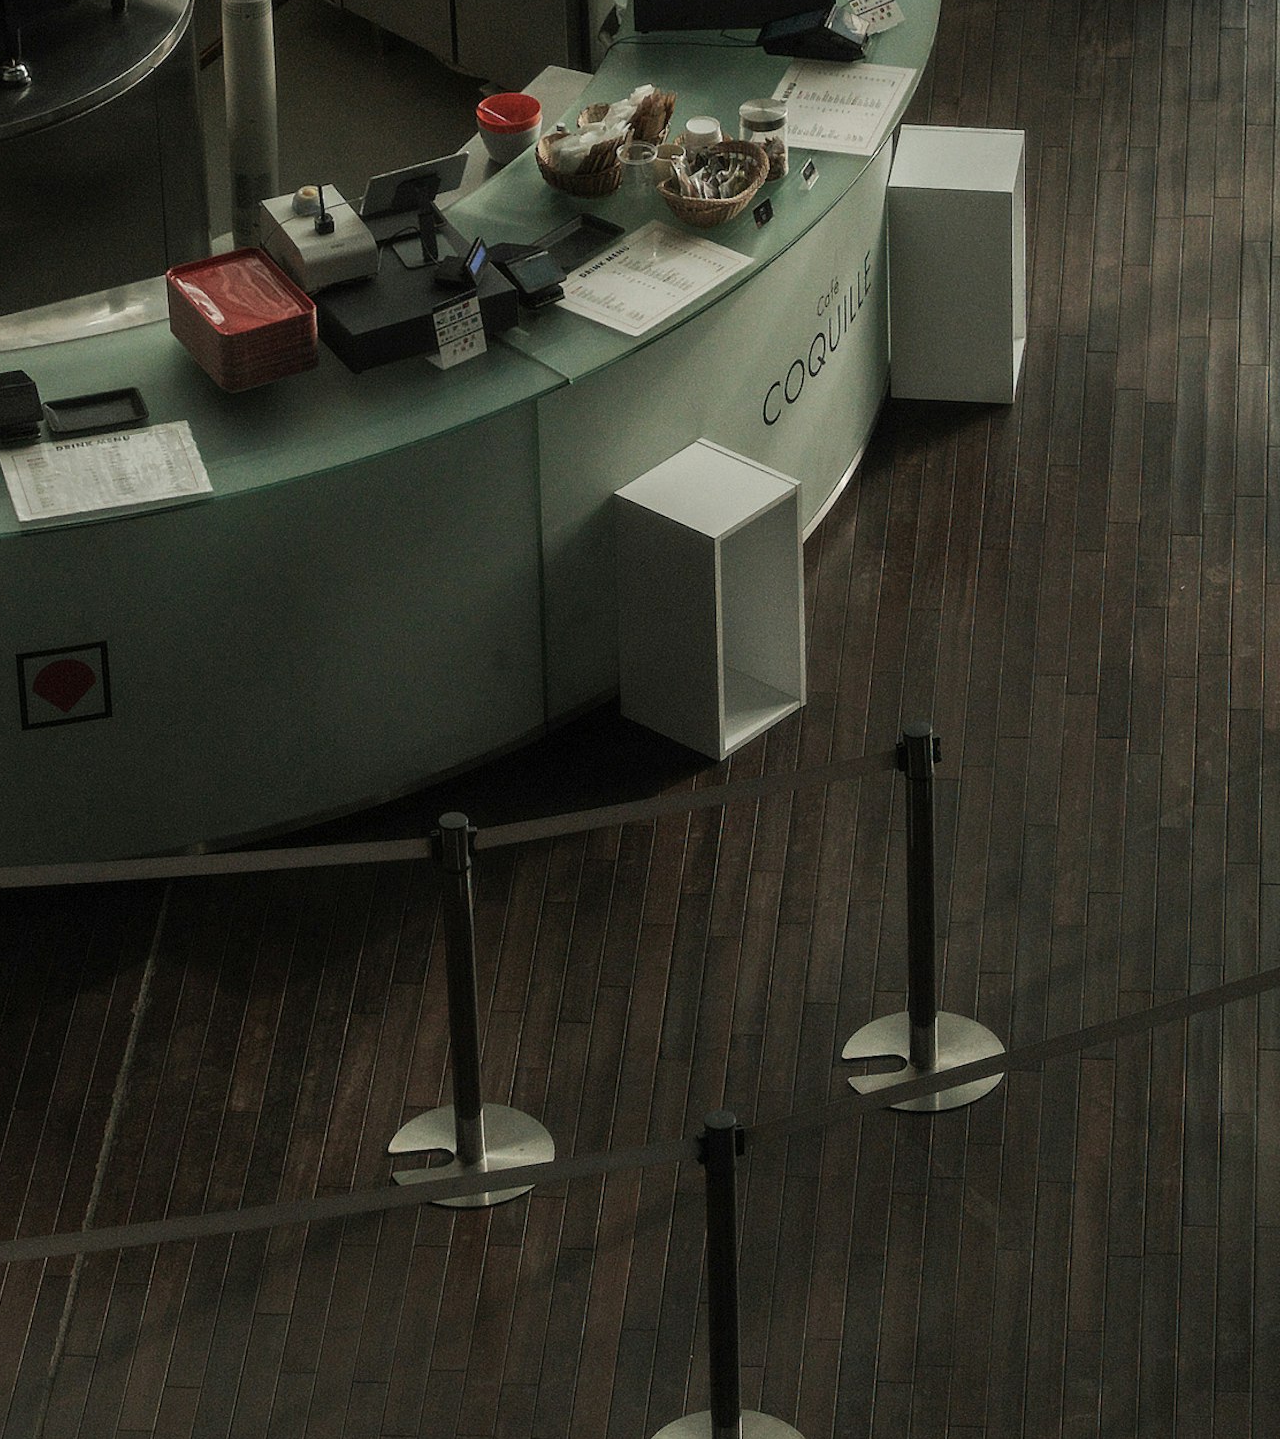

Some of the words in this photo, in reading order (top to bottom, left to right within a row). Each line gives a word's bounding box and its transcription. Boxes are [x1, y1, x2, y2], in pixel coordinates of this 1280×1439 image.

[578, 260, 607, 279] DRINK
[606, 244, 631, 263] MENU
[817, 276, 840, 317] Café
[763, 250, 872, 426] COQUILLE
[55, 440, 93, 452] DRINK
[96, 434, 131, 445] MENU
